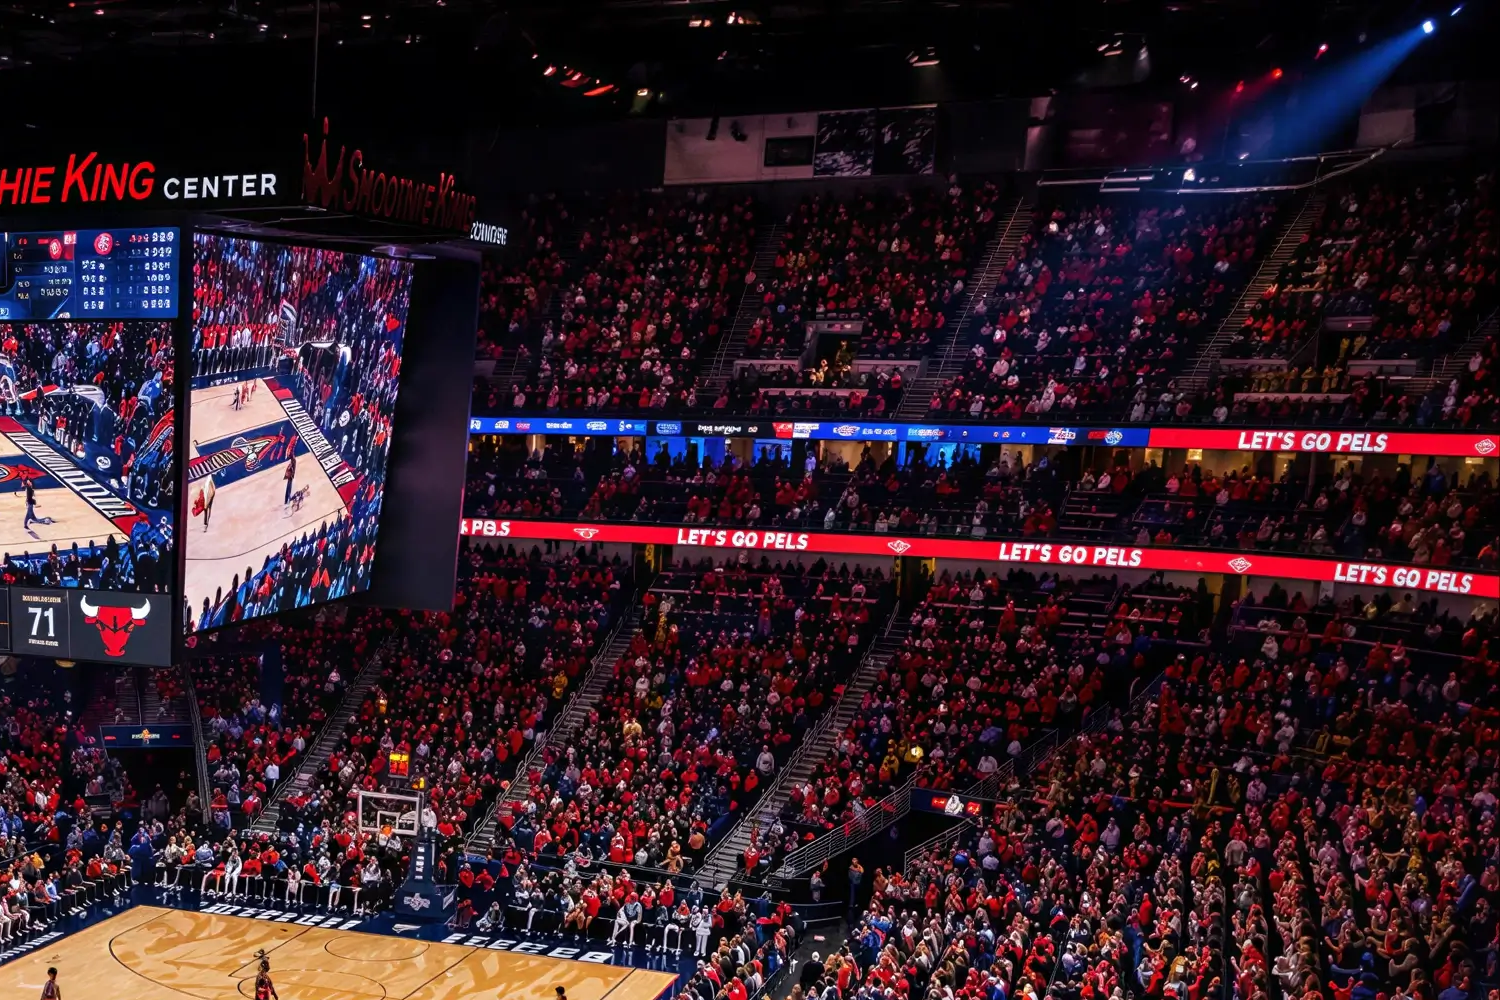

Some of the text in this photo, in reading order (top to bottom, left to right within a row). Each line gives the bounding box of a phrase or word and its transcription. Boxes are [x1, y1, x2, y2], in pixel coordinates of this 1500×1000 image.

[61, 152, 155, 203] KING
[163, 173, 277, 200] CENTER
[1238, 431, 1389, 452] LET'S GO PELS
[677, 528, 809, 550] LET'S GO PELS
[999, 542, 1143, 566] LET'S GO PELS
[1334, 562, 1473, 594] LET'S GO PELS
[28, 607, 55, 637] 71
